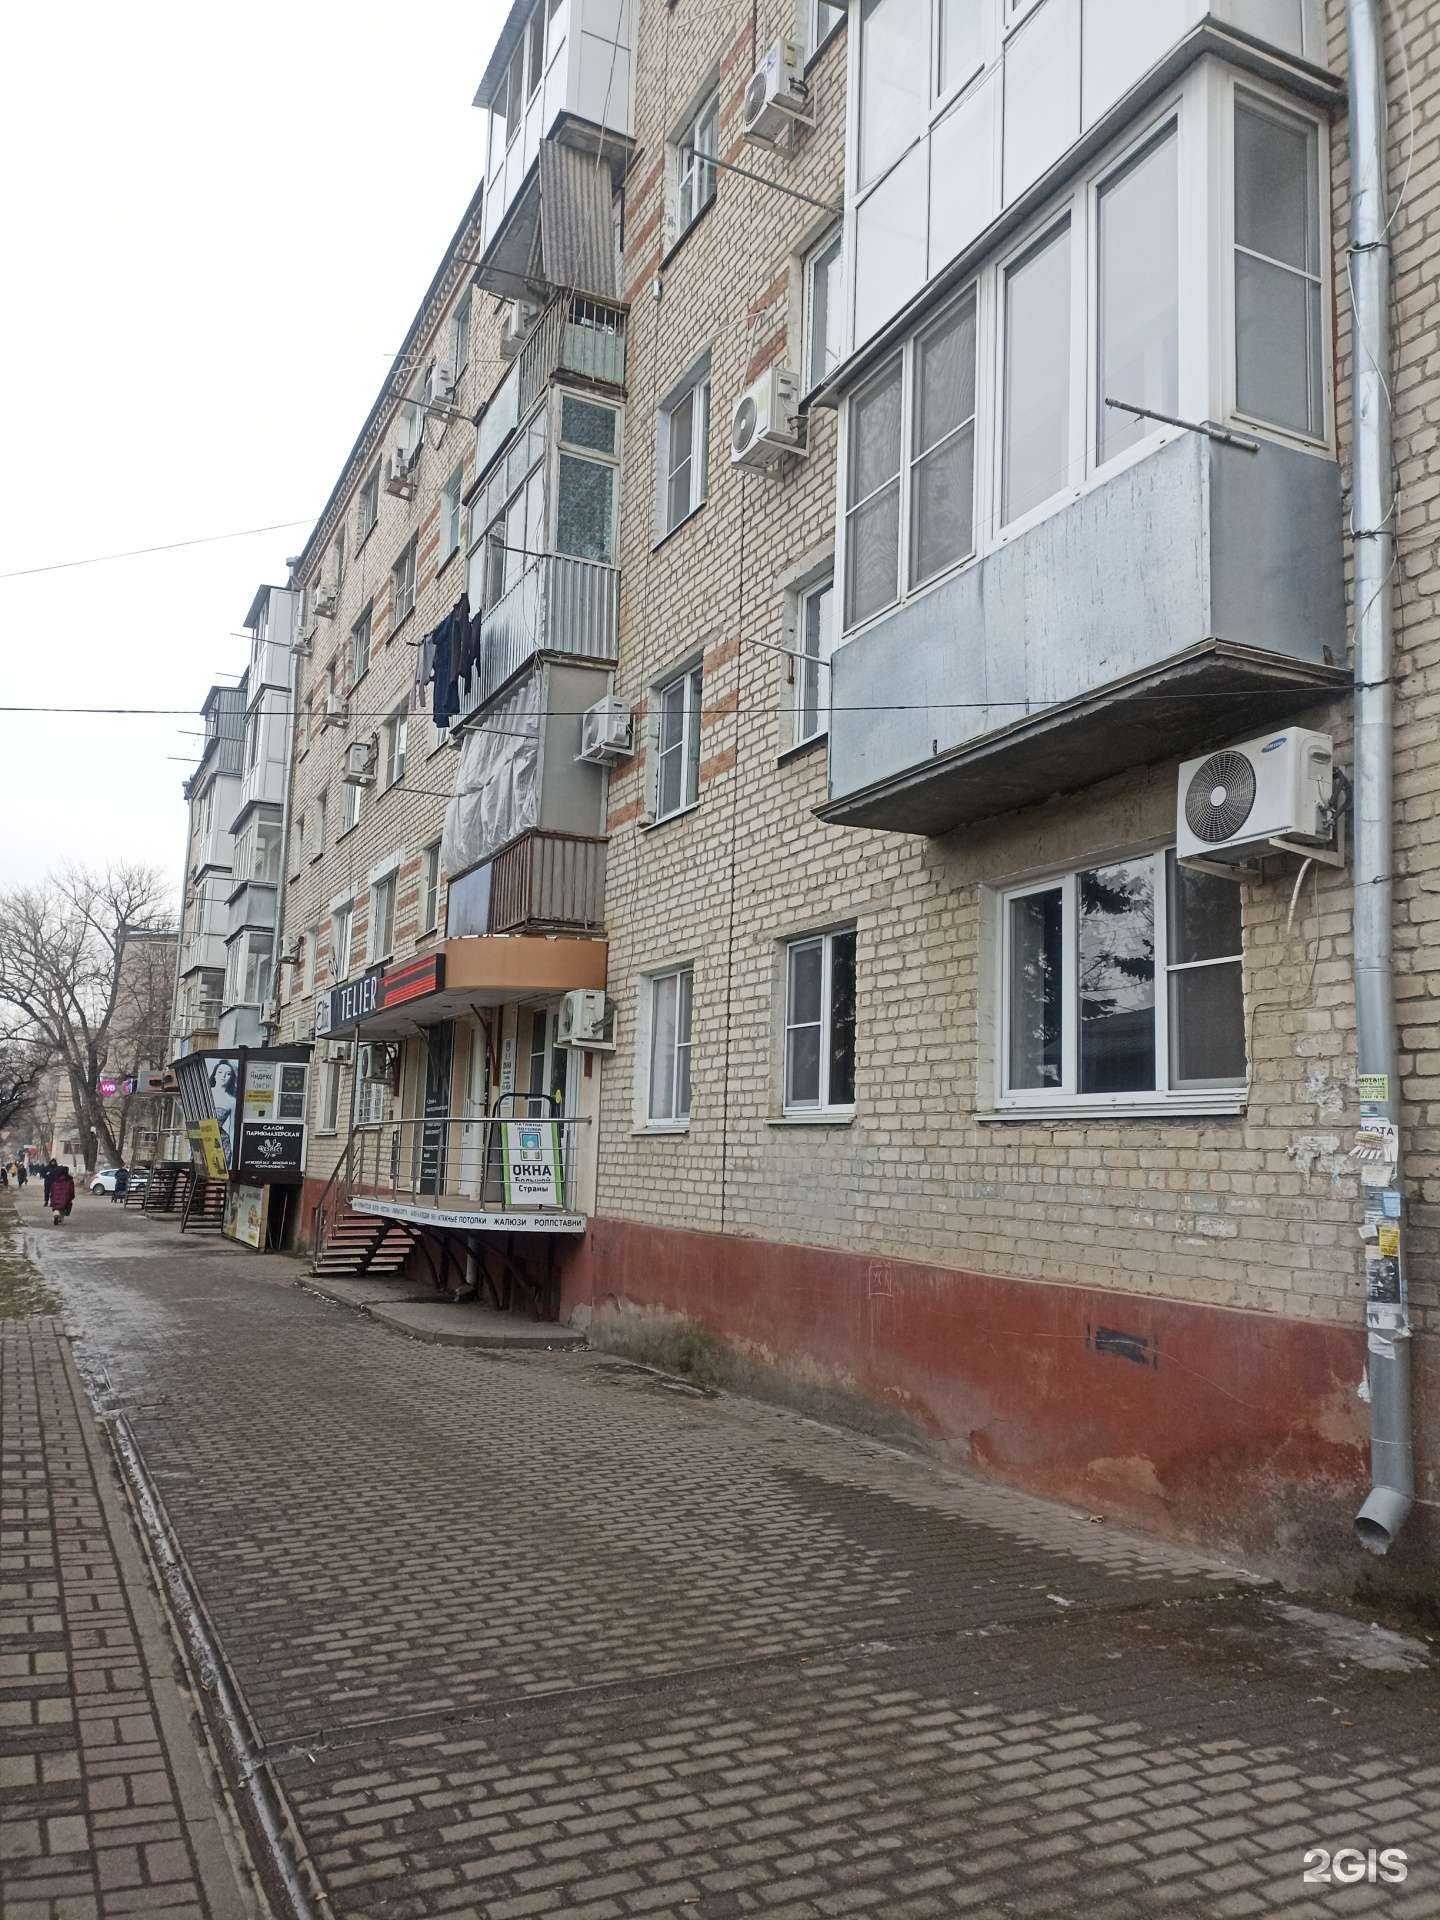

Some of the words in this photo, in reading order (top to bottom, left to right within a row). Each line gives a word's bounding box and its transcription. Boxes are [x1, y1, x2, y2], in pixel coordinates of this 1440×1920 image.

[512, 1164, 552, 1176] ОКНА
[518, 1185, 549, 1194] Страны
[493, 1217, 527, 1226] ЖАЛЮЗИ
